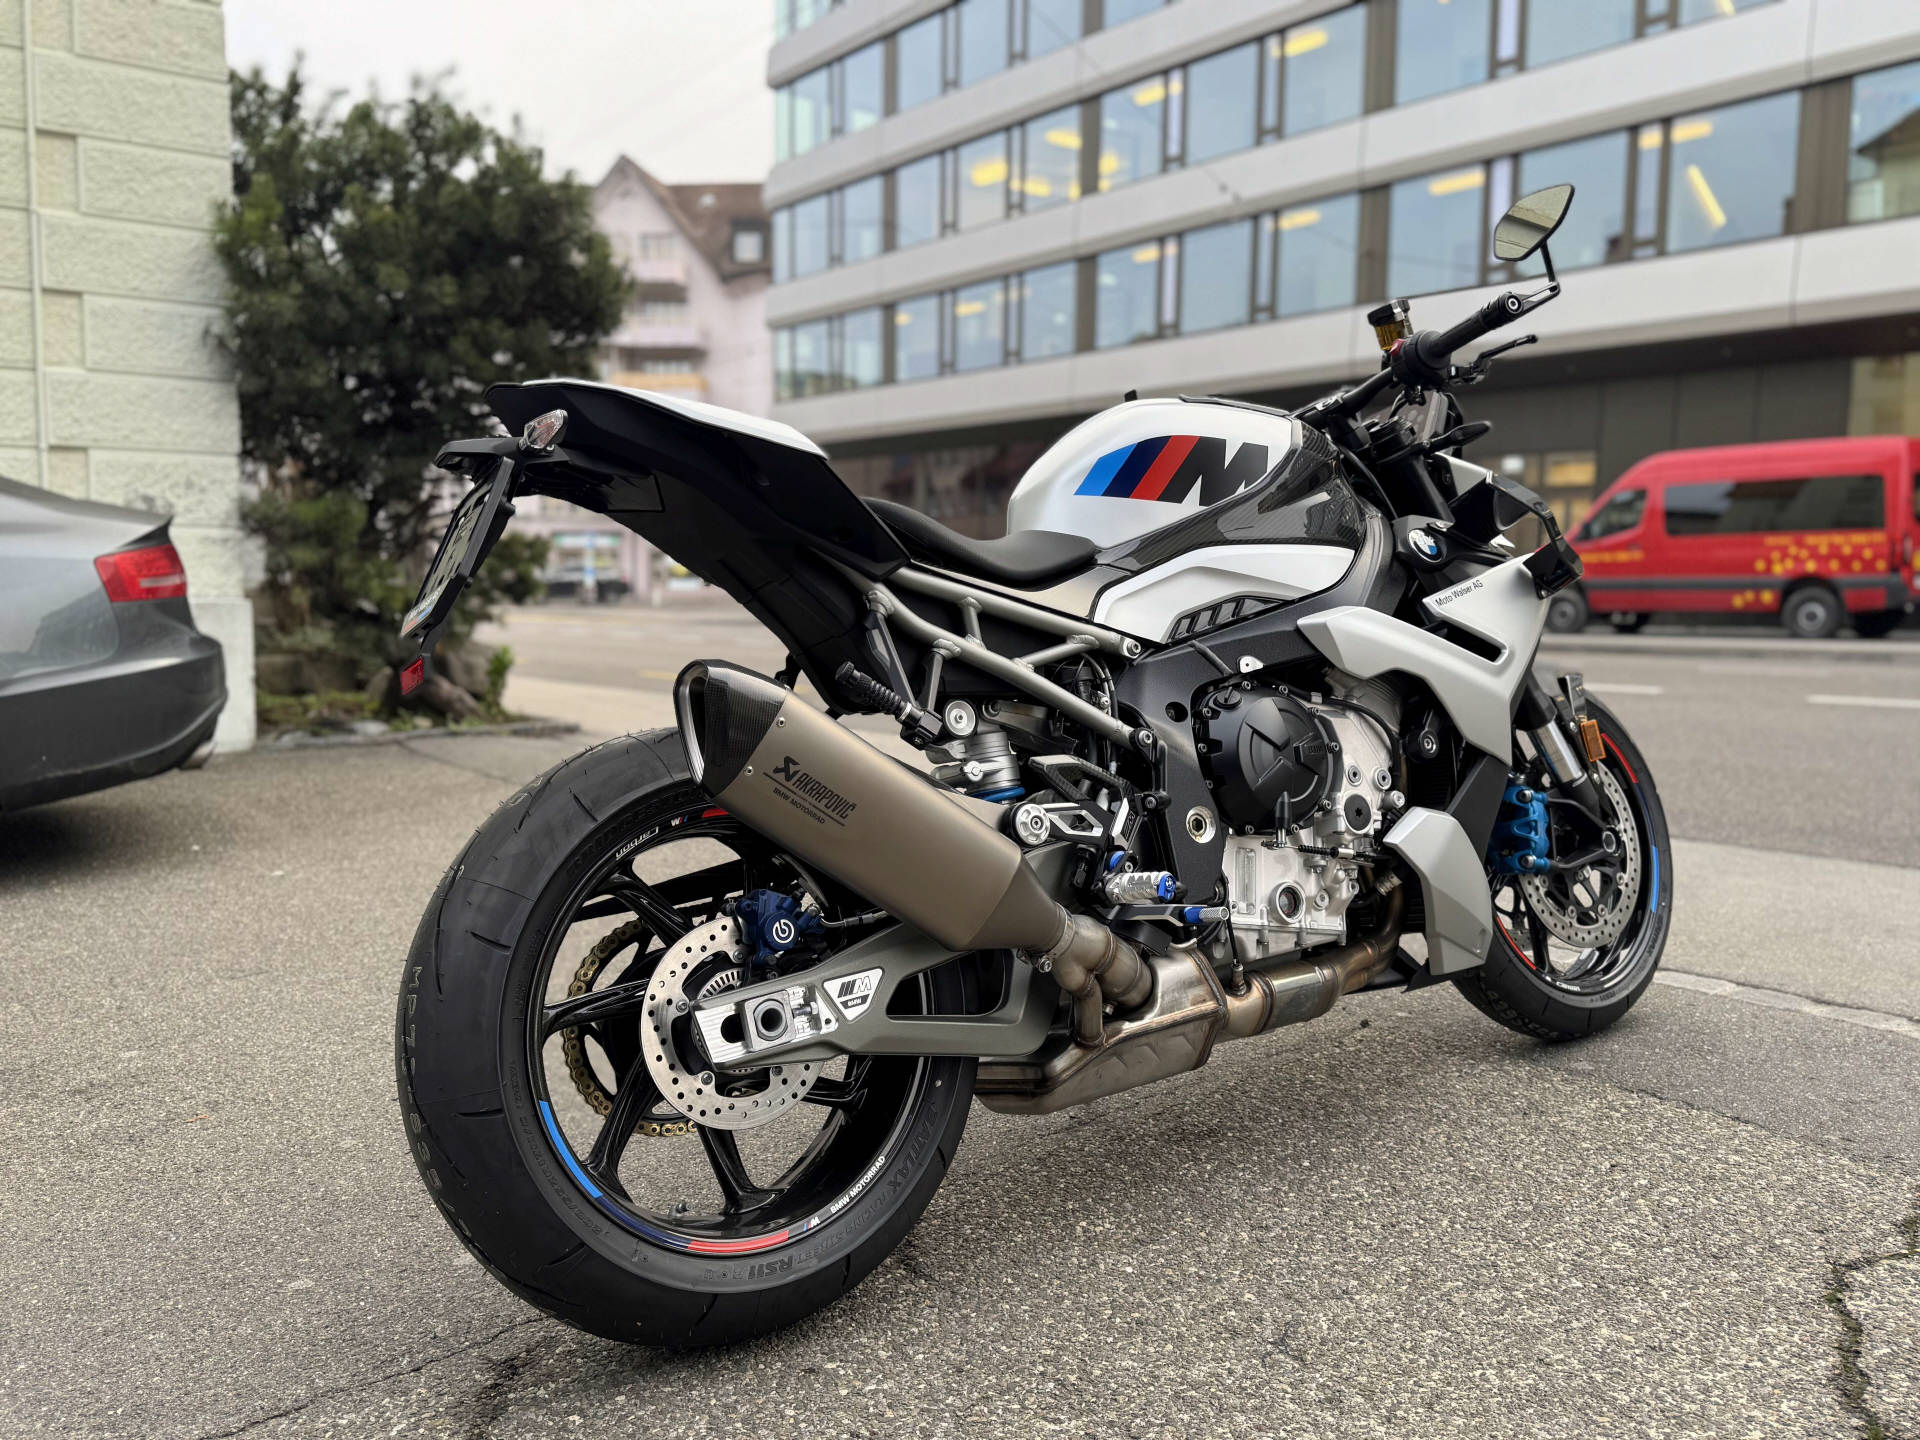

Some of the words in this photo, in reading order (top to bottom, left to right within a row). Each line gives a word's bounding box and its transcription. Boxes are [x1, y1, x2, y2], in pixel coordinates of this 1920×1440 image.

[1435, 594, 1453, 607] Moto
[1453, 585, 1473, 599] Walser
[1473, 579, 1484, 590] AG
[773, 787, 789, 801] BMW
[789, 798, 826, 825] MOTORRAD
[830, 1194, 850, 1214] BMW
[849, 1156, 886, 1198] MOTORRAD
